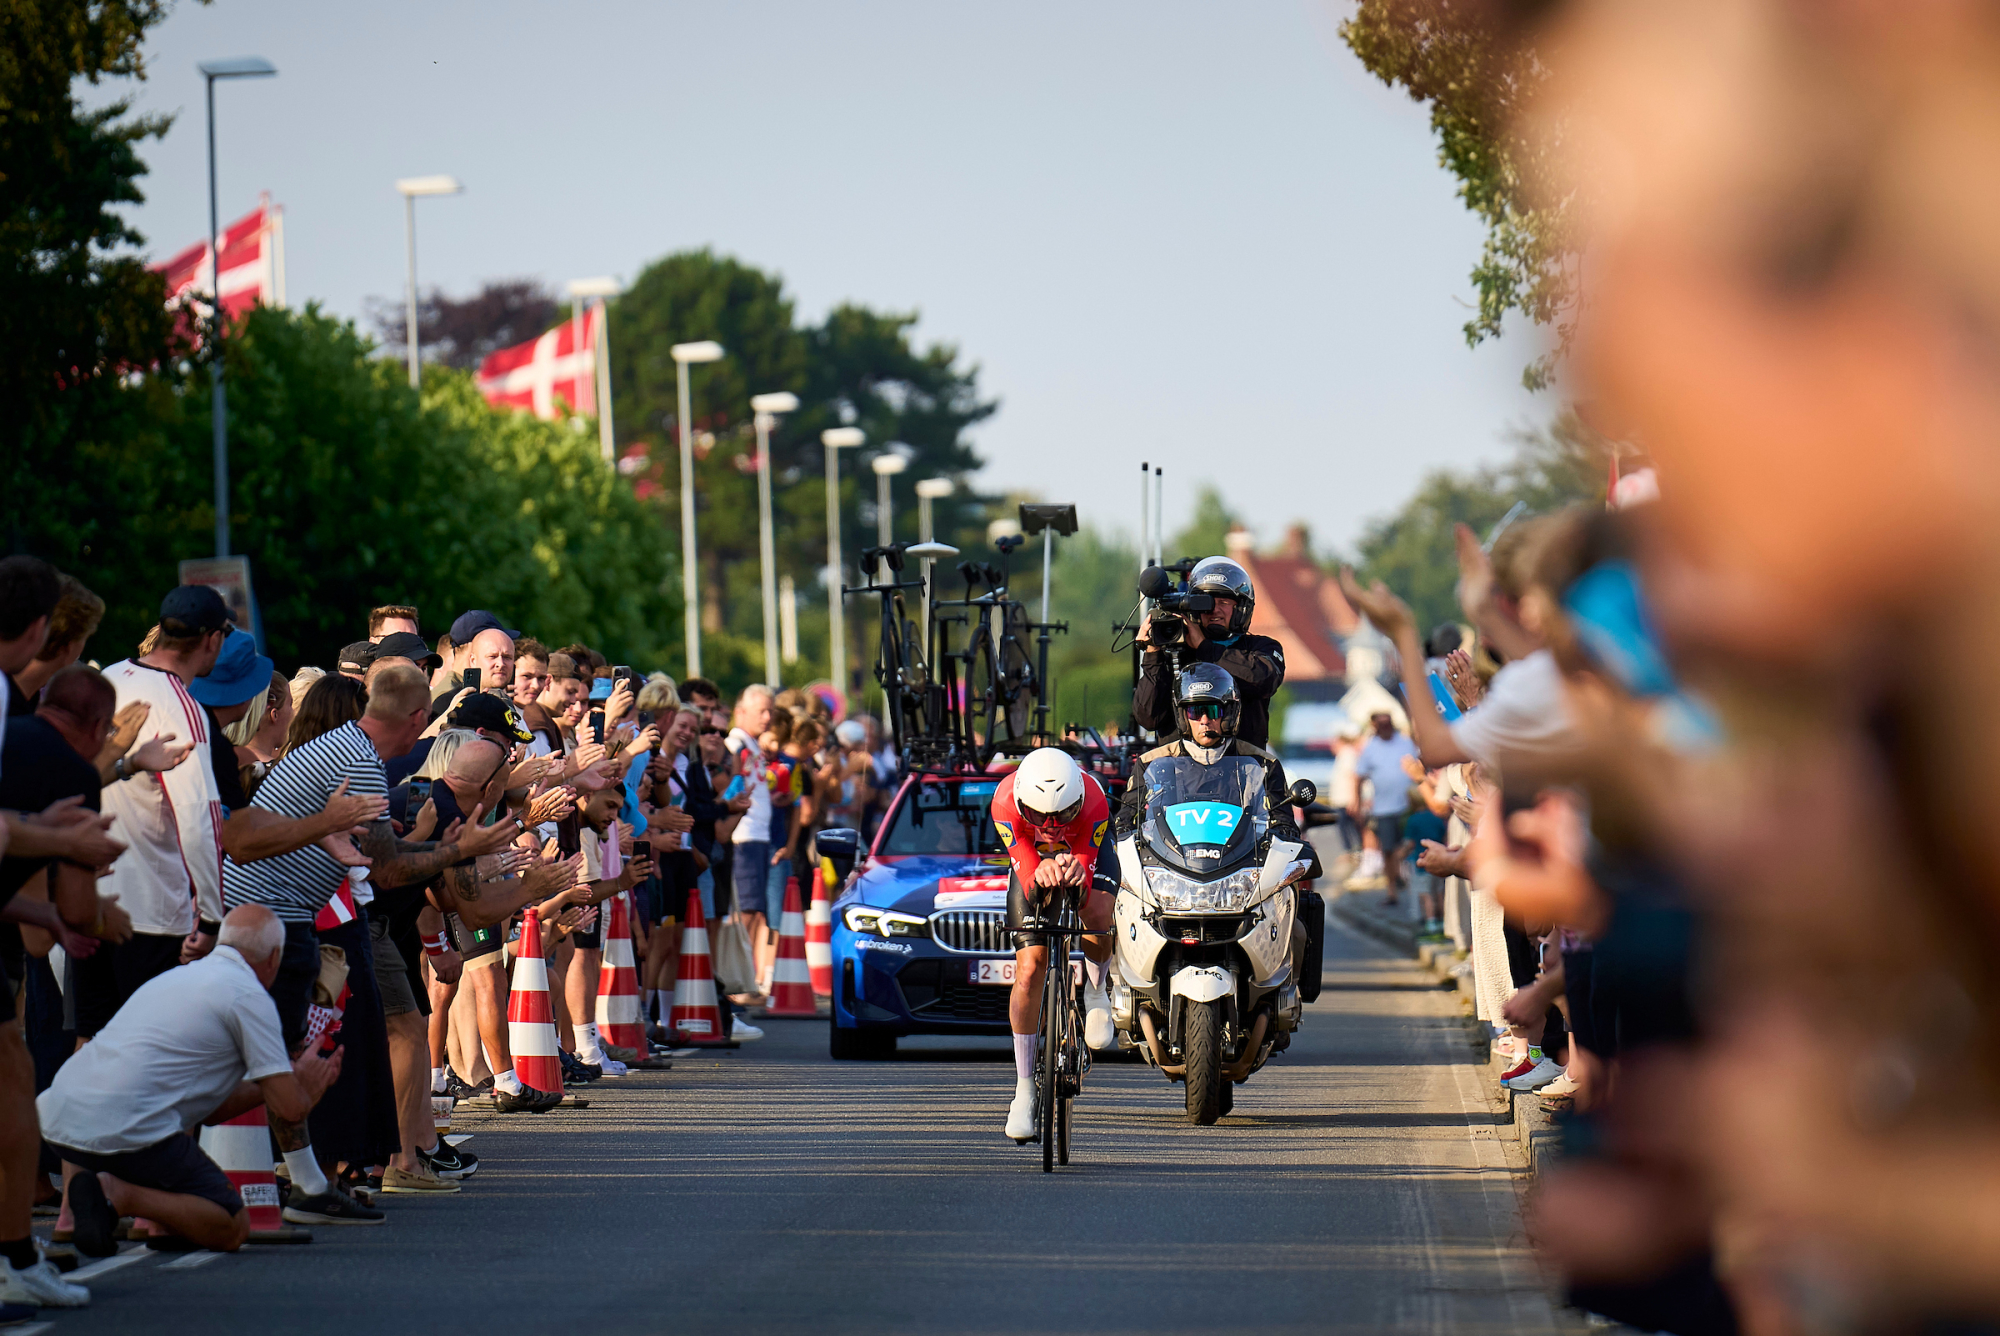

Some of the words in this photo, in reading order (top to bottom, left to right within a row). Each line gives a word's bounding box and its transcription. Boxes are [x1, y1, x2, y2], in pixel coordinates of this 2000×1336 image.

[1175, 808, 1211, 827] TV
[1217, 810, 1233, 828] 2
[1195, 848, 1221, 859] EMG
[970, 972, 978, 980] B
[1195, 970, 1223, 981] EMG
